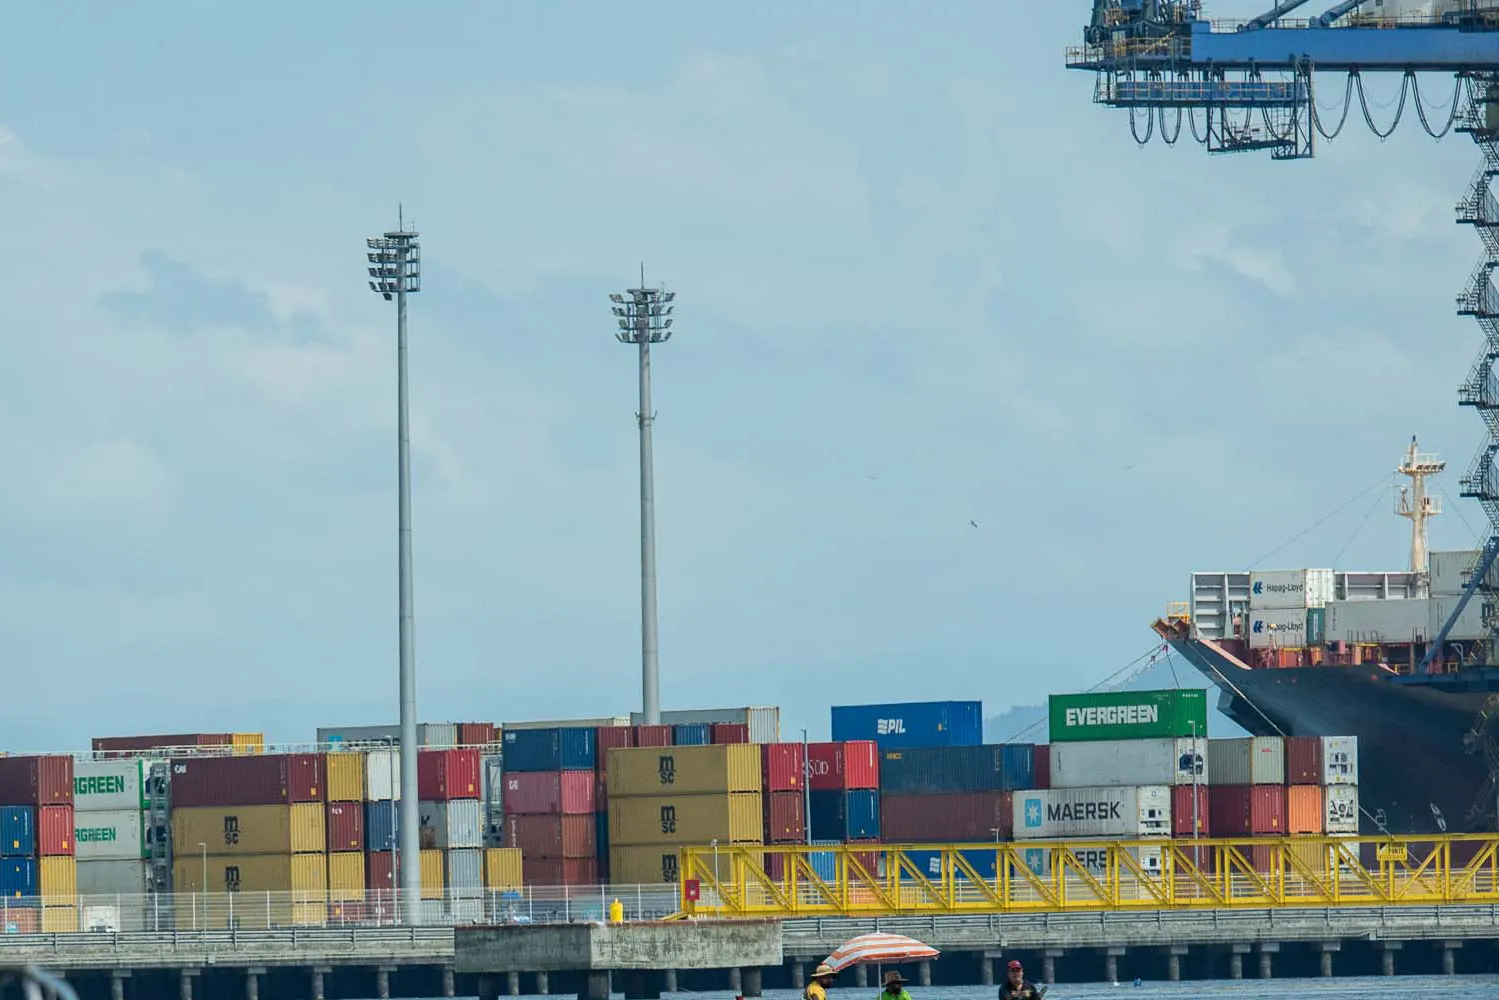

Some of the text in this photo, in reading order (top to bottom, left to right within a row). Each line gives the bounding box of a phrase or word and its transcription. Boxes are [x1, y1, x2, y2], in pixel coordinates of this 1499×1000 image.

[1266, 621, 1303, 633] Hpag-Lloyd
[1066, 704, 1159, 727] EVERGREEN
[887, 720, 906, 734] PIL
[1047, 801, 1120, 821] MAERSK
